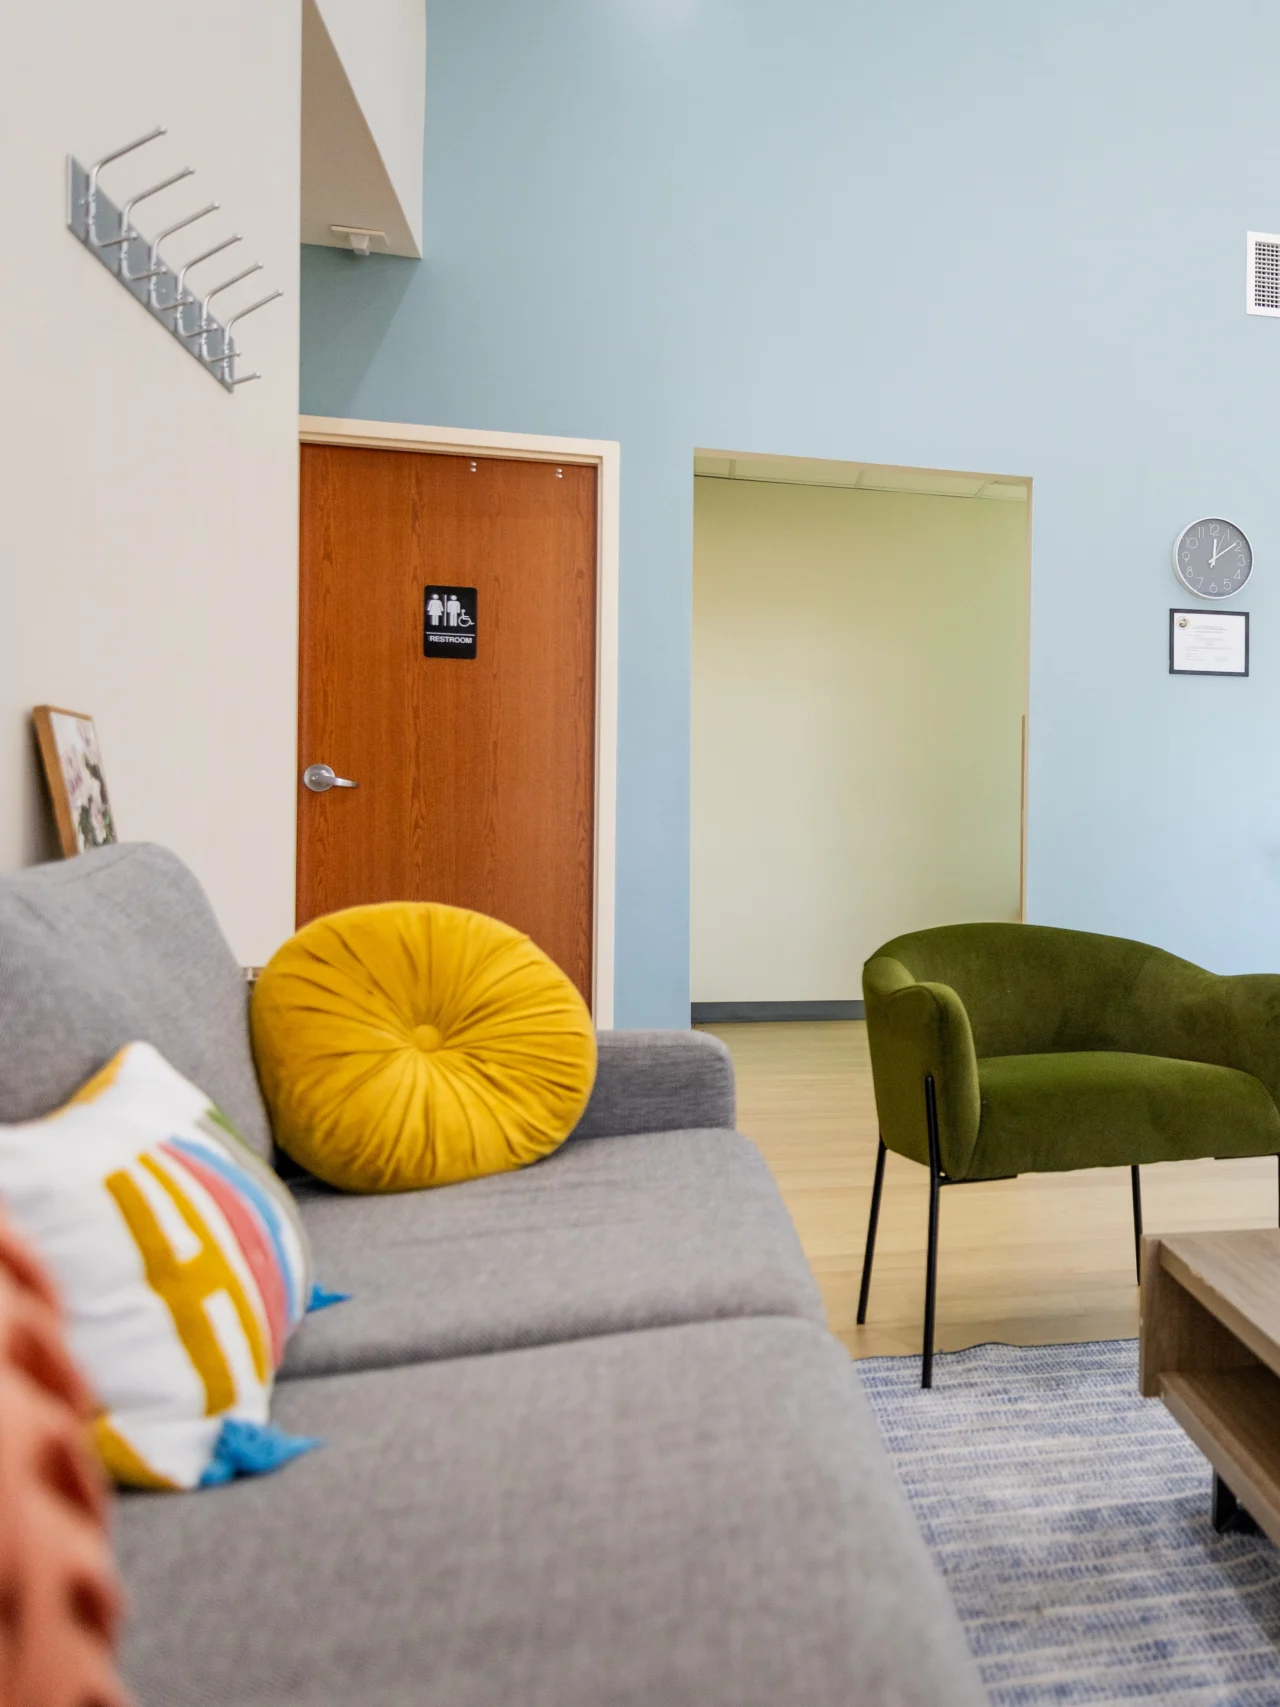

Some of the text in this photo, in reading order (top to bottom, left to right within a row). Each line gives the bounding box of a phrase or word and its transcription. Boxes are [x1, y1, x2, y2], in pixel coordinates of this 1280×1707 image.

[1198, 526, 1205, 539] 11
[1209, 523, 1220, 536] 12
[1185, 536, 1199, 549] 10
[1234, 539, 1243, 552] 2
[1181, 551, 1191, 563] 9
[1237, 554, 1246, 567] 3
[1185, 565, 1194, 578] 8
[1233, 569, 1241, 580] 4
[1195, 576, 1204, 589] 7
[1209, 581, 1218, 594] 6
[1223, 578, 1232, 591] 5
[429, 635, 473, 644] RESTROOM
